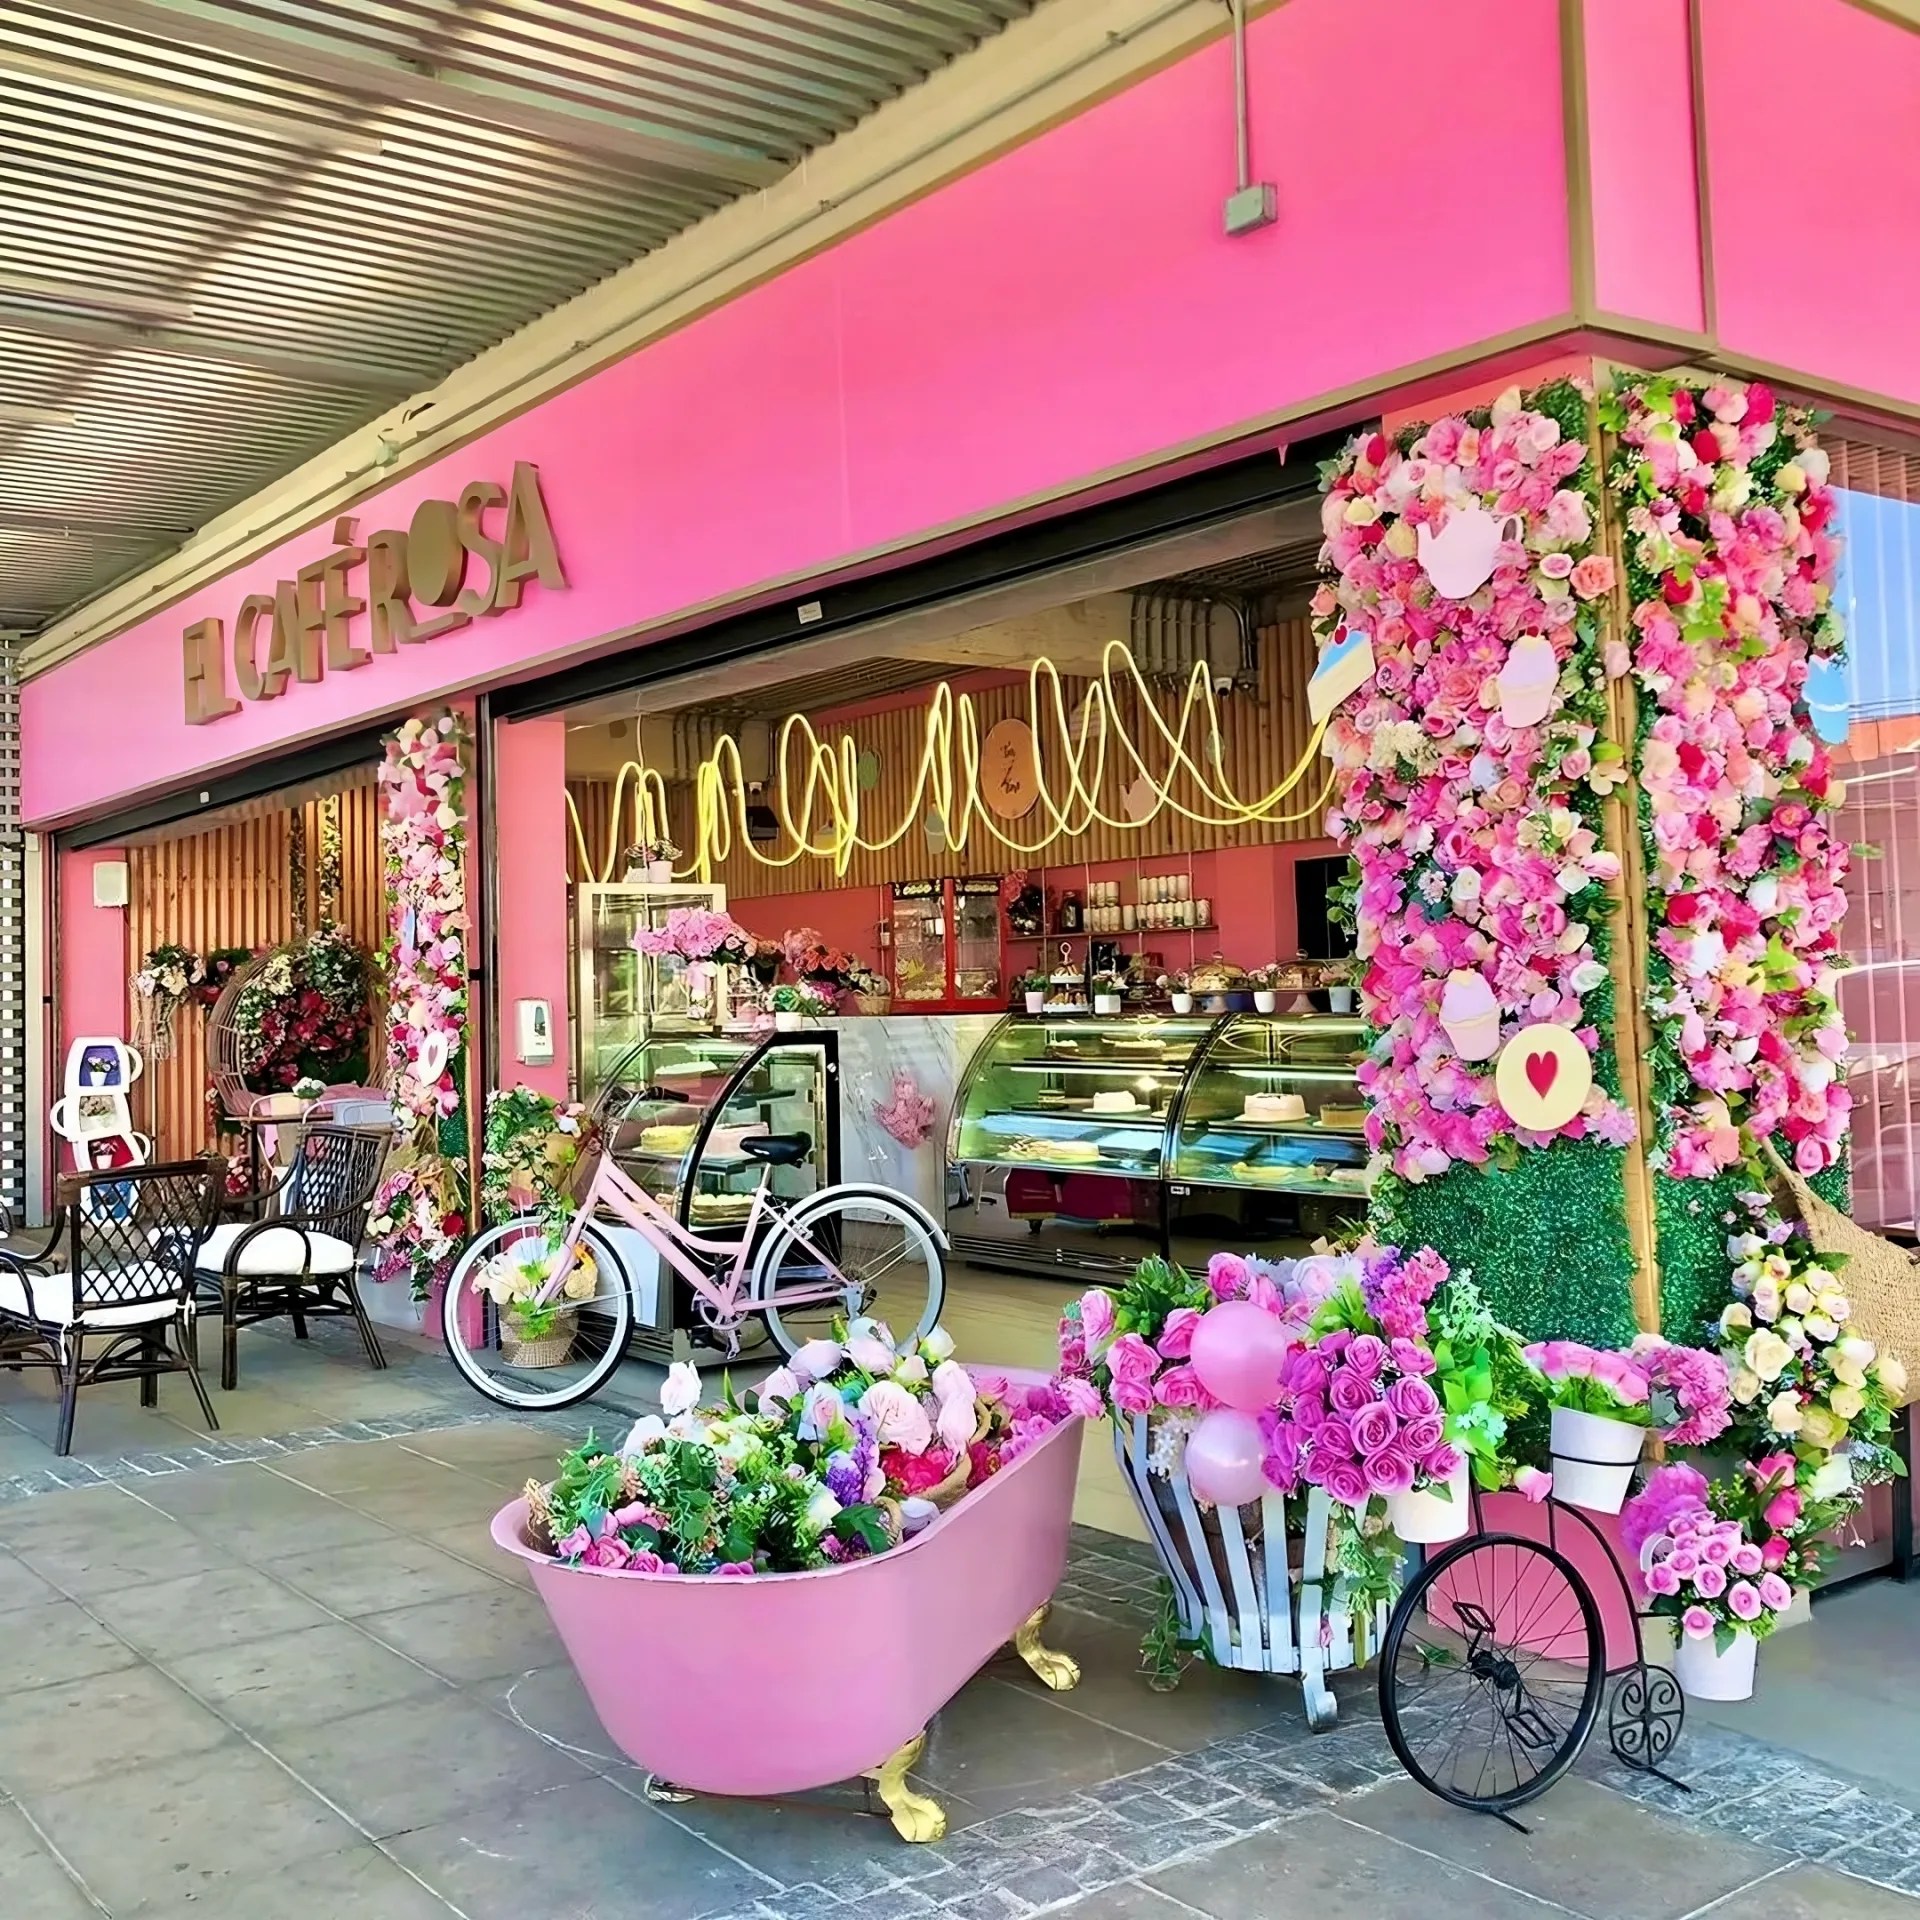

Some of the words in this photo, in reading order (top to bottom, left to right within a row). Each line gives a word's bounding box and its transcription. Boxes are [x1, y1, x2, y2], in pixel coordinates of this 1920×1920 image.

[182, 617, 243, 725] EL
[234, 516, 373, 701] CAFÉ
[367, 460, 570, 654] ROSA
